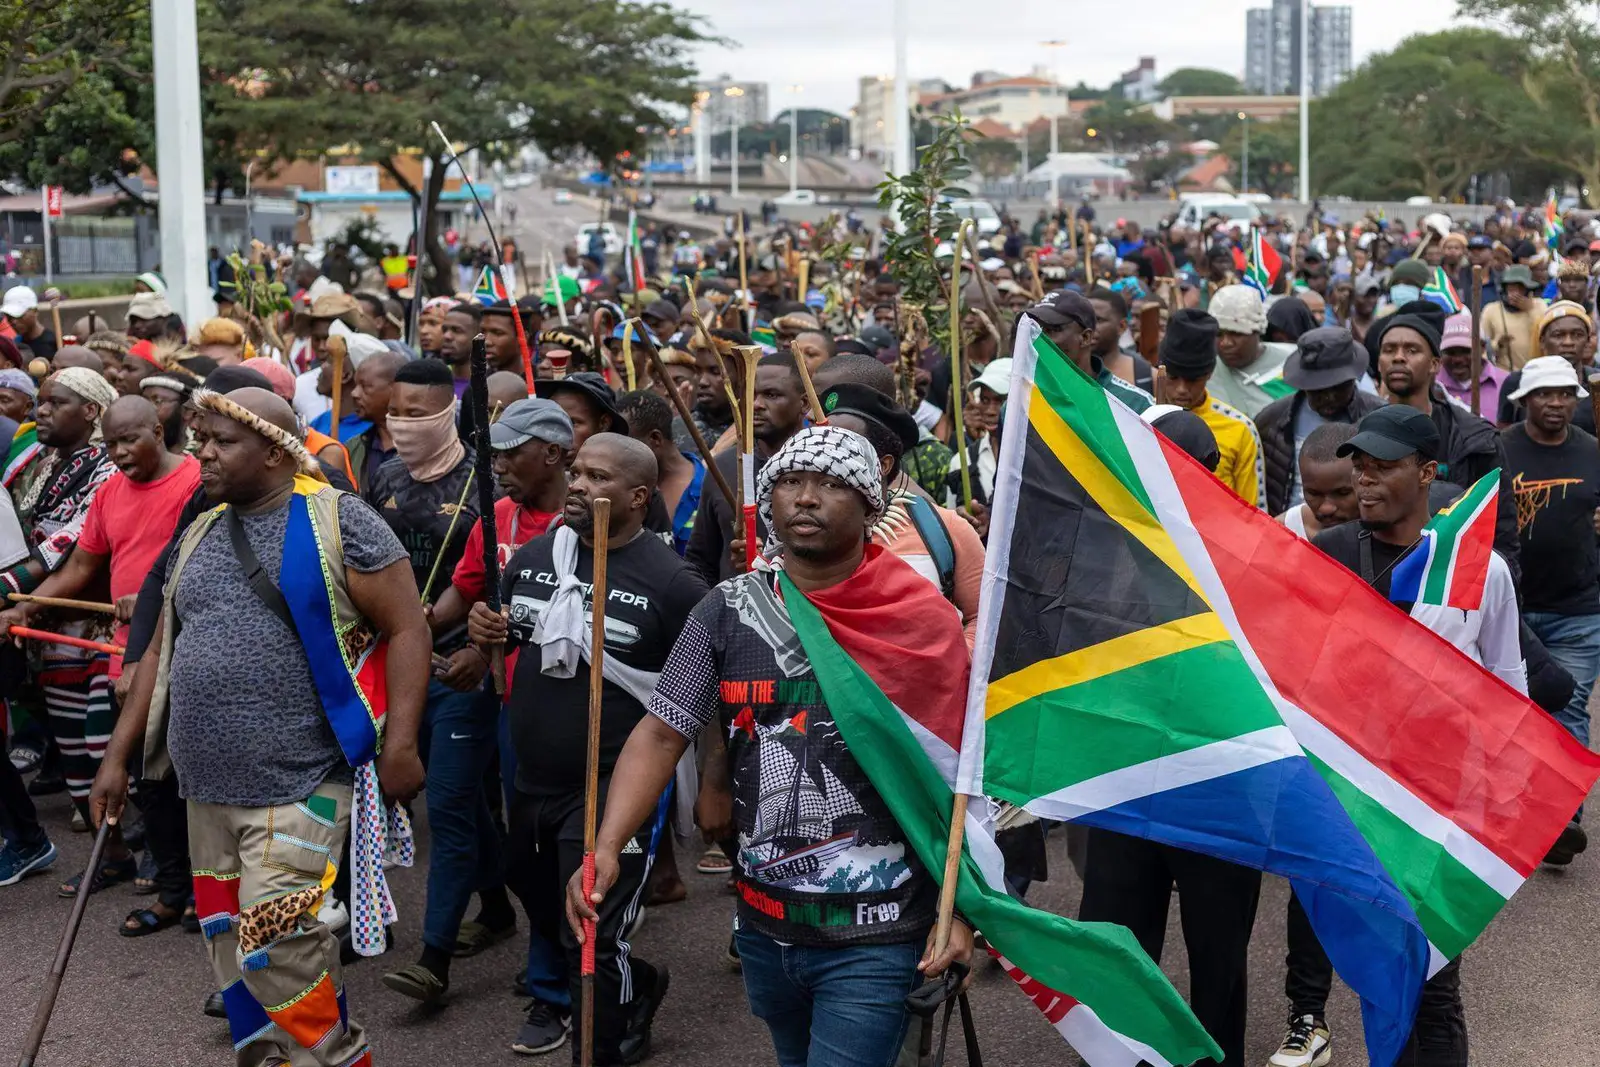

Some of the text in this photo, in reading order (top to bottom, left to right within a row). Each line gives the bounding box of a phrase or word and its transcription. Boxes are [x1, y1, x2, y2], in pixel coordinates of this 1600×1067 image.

[520, 569, 533, 580] A
[608, 588, 649, 611] FOR
[719, 681, 748, 704] FROM
[752, 680, 776, 704] THE
[779, 681, 817, 705] RIVER
[764, 854, 820, 883] SUMUD
[856, 902, 900, 925] Free
